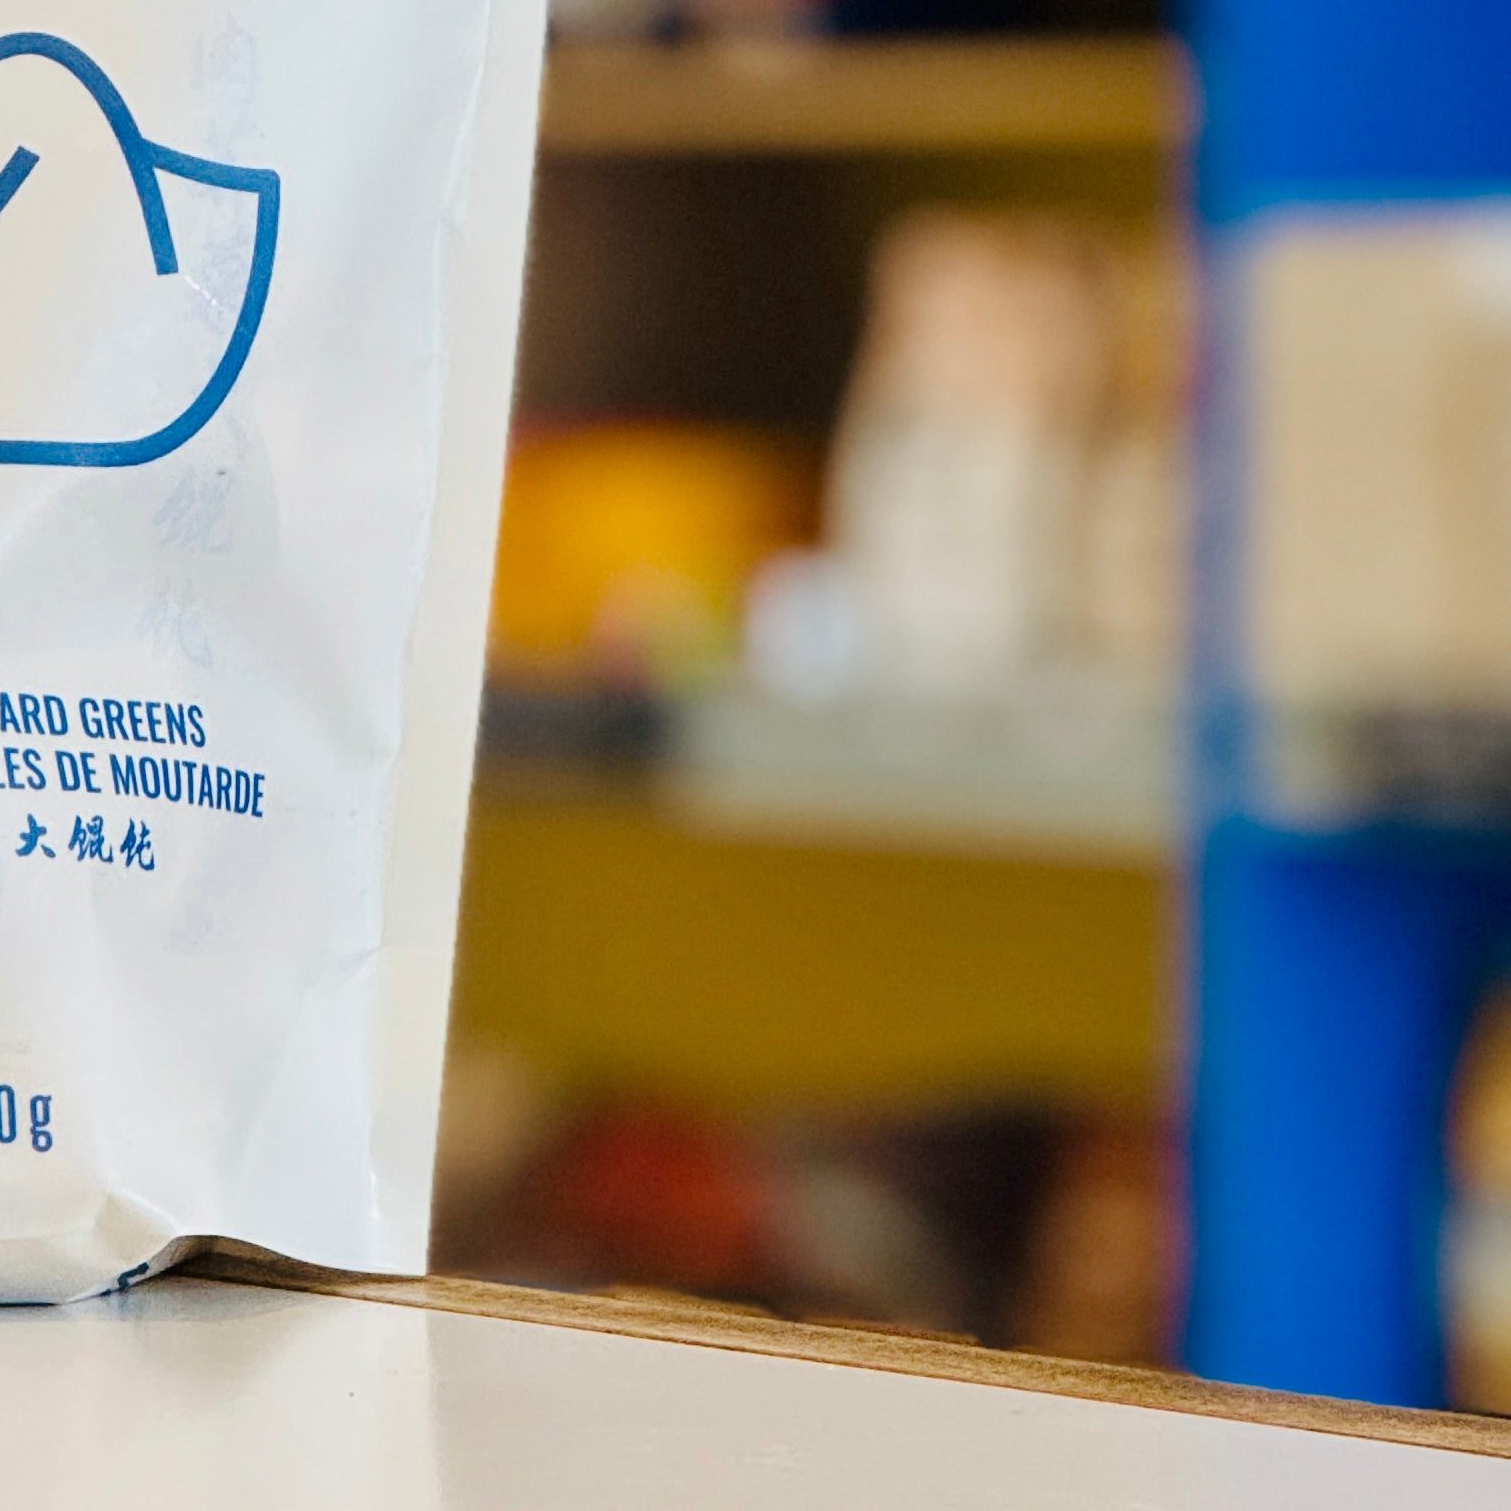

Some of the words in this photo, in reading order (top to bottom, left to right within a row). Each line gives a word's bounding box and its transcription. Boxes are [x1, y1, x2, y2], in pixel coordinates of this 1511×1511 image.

[78, 697, 207, 749] GREENS
[54, 750, 102, 794] DE
[109, 753, 266, 819] MOUTARDE
[28, 1093, 54, 1153] g
